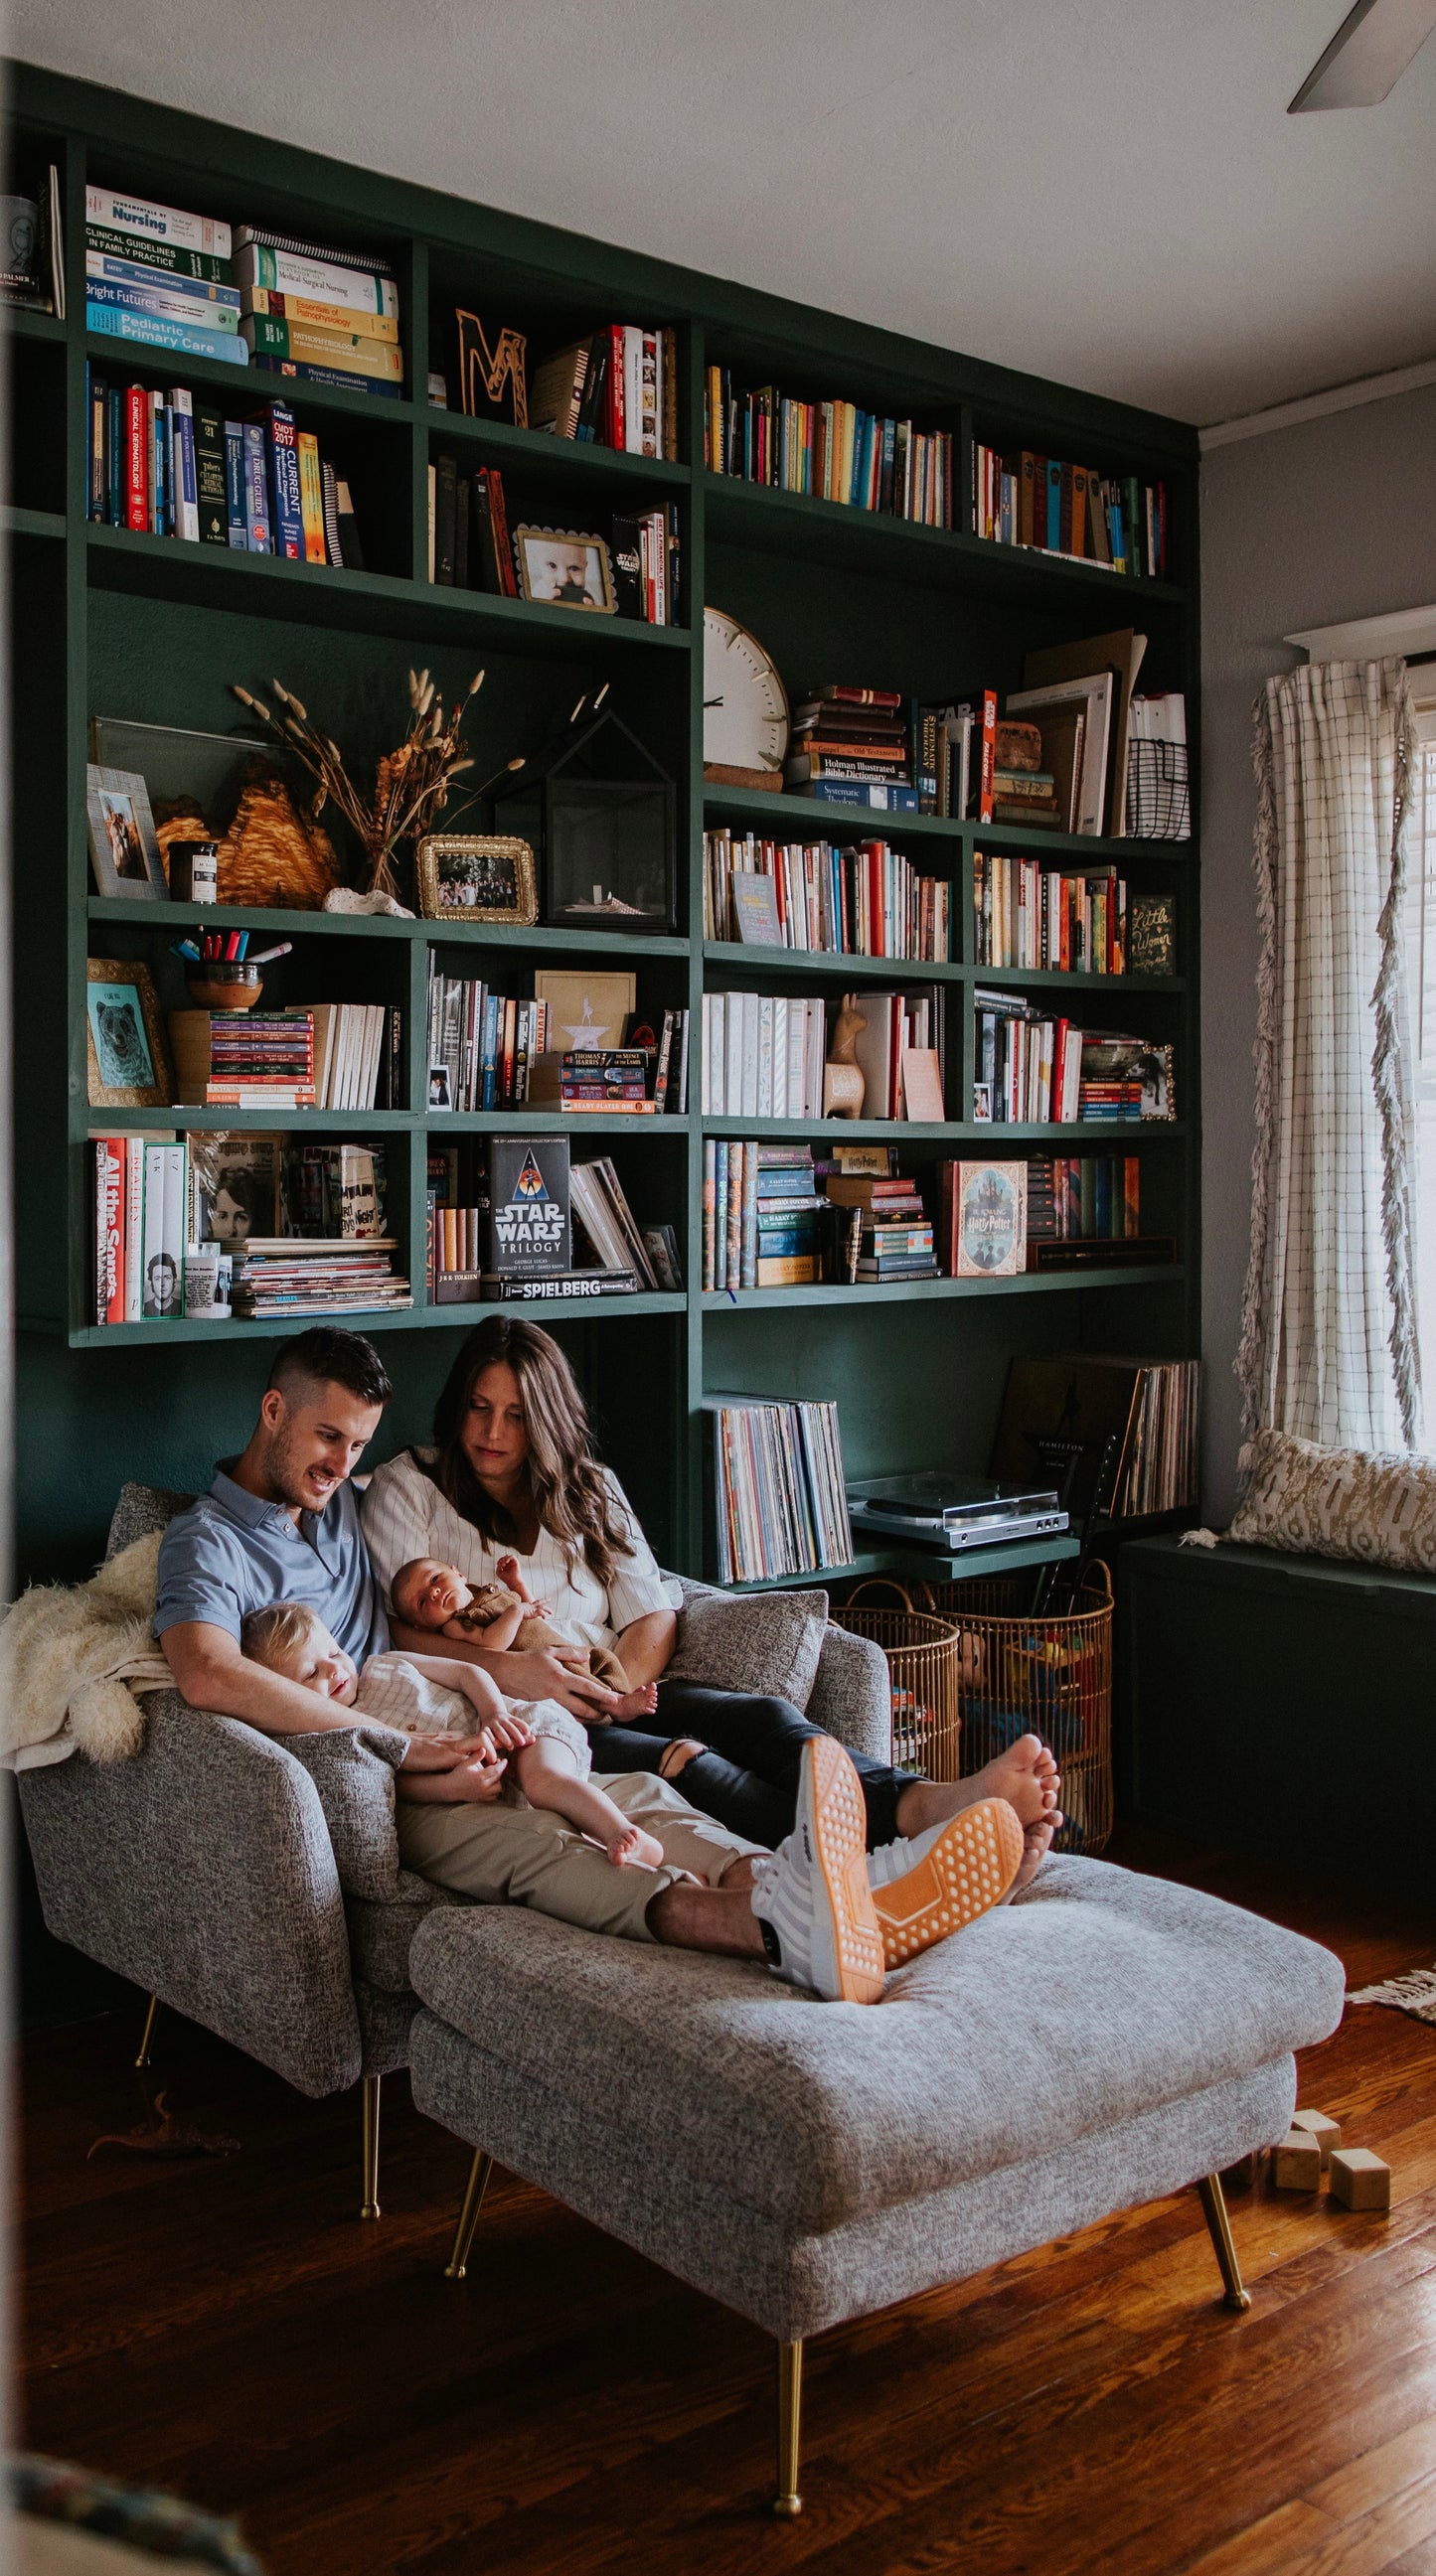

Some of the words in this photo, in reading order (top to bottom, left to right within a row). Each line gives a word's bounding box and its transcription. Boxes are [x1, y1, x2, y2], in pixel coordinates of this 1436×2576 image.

[113, 200, 157, 216] FUNDAMENTALS
[113, 206, 166, 234] Nursing
[86, 227, 124, 245] CLINICAL
[126, 237, 176, 258] GUIDELINES
[89, 238, 98, 247] IN
[99, 240, 131, 257] FAMILY
[133, 249, 174, 268] PRACTICE
[135, 271, 153, 281] Physical
[154, 274, 183, 288] Examination
[326, 283, 348, 297] Nursing
[117, 290, 157, 309] Futures
[297, 300, 330, 314] Essentials
[121, 313, 183, 336] Pediatric
[297, 308, 351, 328] Pathophysiology
[121, 326, 178, 348] Primary
[182, 338, 215, 353] Care
[293, 332, 356, 353] PATHOPHYSIOLOGY
[308, 368, 331, 379] Physical
[332, 373, 367, 386] Examination
[456, 308, 527, 429] M
[273, 409, 293, 422] LANGE
[205, 427, 215, 437] 21
[274, 423, 294, 435] CMDT
[275, 433, 294, 446] 2017
[253, 458, 262, 484] DRUG
[287, 450, 300, 515] CURRENT
[616, 553, 639, 561] STAR
[617, 559, 639, 570] WARS
[824, 759, 856, 770] Holman
[857, 762, 895, 773] Illustrated
[825, 768, 845, 778] Bible
[846, 771, 886, 783] Dictionary
[824, 785, 860, 797] Systematic
[1132, 907, 1168, 930] Little
[1132, 931, 1171, 950] Women
[520, 1010, 528, 1021] The
[518, 1022, 528, 1050] Godfather
[517, 1065, 525, 1083] Mario
[107, 1155, 120, 1186] All
[848, 1157, 862, 1168] Harry
[862, 1156, 877, 1167] Potter
[131, 1157, 141, 1222] BEATLES
[107, 1189, 119, 1226] the
[495, 1204, 565, 1222] STAR
[496, 1222, 565, 1242] WARS
[968, 1216, 989, 1233] Harry
[989, 1215, 1010, 1232] Potter
[501, 1242, 561, 1254] TRILOGY
[107, 1228, 119, 1297] Songs
[523, 1280, 601, 1298] SPIELBERG
[1039, 1440, 1084, 1451] HAMILTON
